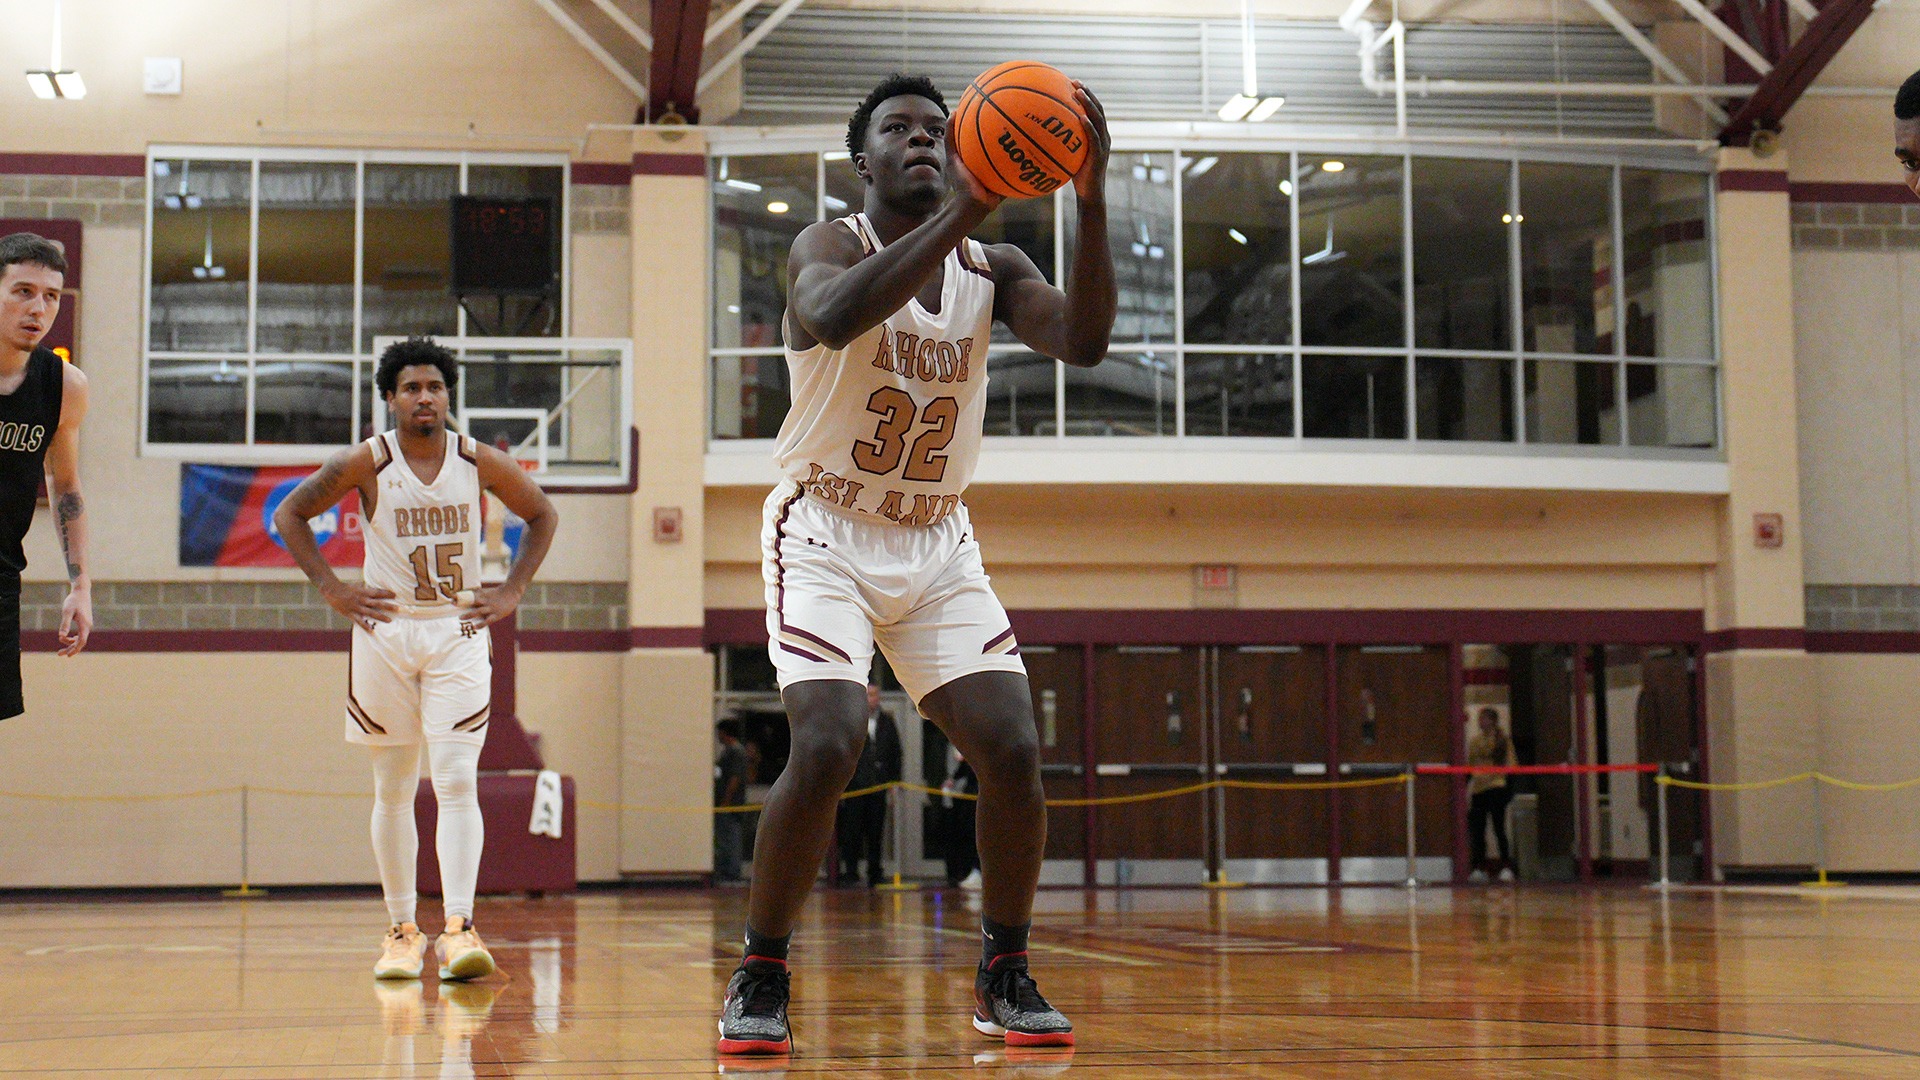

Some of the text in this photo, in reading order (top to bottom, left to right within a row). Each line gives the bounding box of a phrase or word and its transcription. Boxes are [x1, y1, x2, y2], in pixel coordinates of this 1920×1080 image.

[998, 131, 1061, 192] Wilson
[1041, 116, 1083, 154] EVO
[872, 323, 974, 383] RHODE
[0, 422, 45, 452] OLS
[851, 385, 959, 483] 32
[394, 503, 470, 538] RHODE
[408, 542, 464, 601] 15
